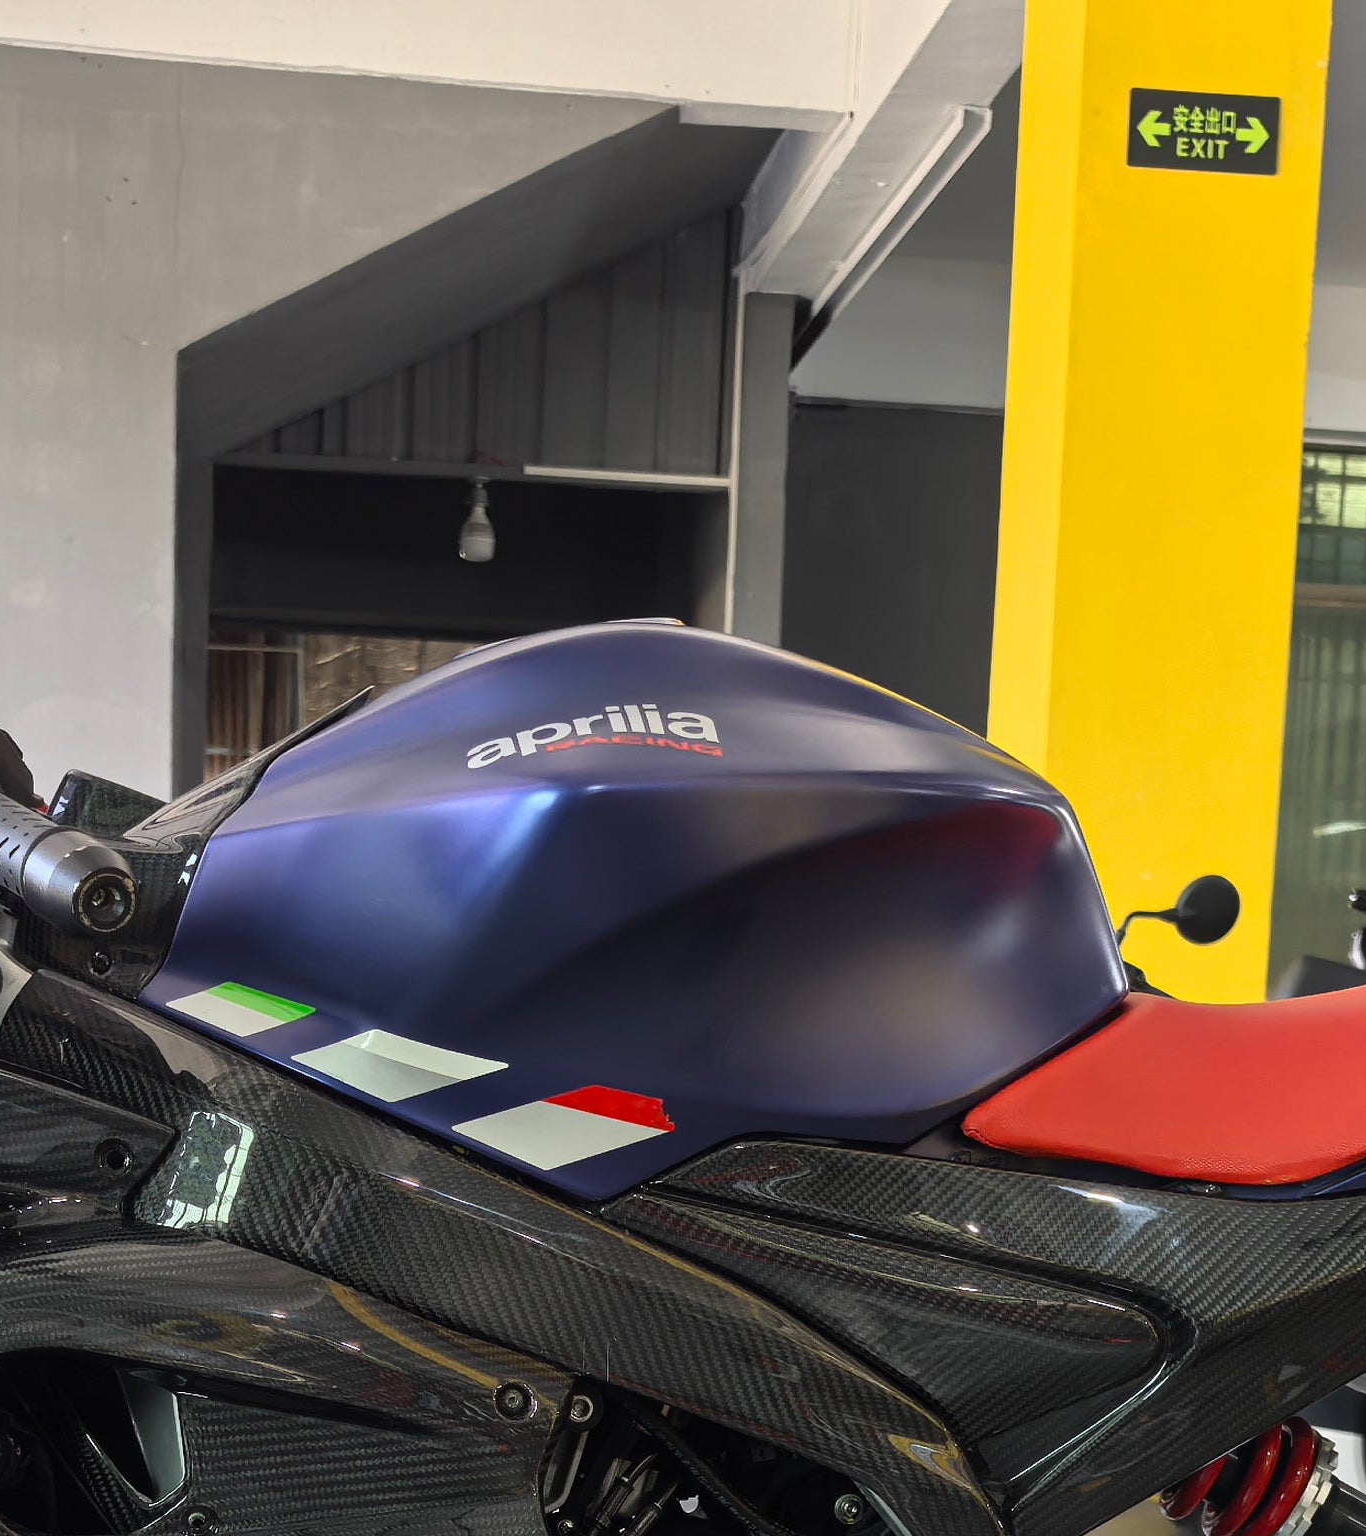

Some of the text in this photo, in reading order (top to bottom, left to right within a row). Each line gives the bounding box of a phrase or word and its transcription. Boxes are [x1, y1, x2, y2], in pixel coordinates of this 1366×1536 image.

[1172, 104, 1237, 135] 安全出口
[1175, 137, 1230, 160] EXIT
[466, 703, 721, 769] aprilia
